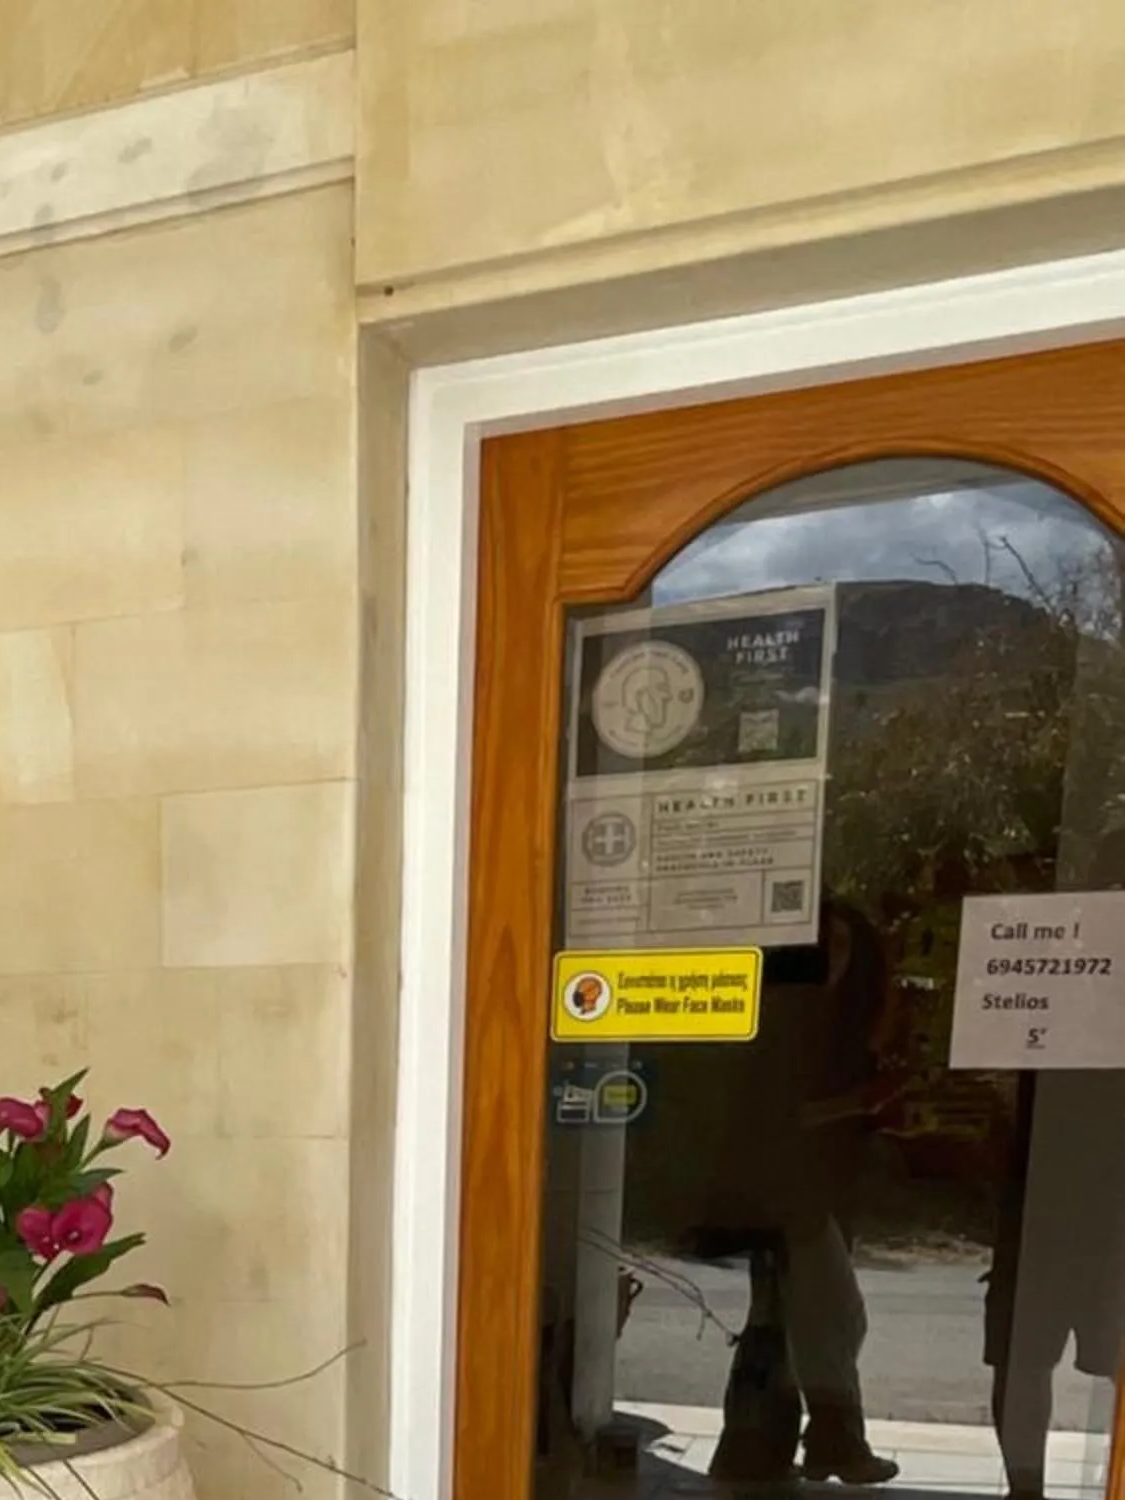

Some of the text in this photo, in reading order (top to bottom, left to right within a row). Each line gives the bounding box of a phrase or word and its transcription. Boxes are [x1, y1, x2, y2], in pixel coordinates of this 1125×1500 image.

[727, 631, 800, 652] HEALTH
[736, 646, 788, 664] FIRST
[746, 788, 808, 805] FIRST
[990, 921, 1080, 940] Call me !
[986, 957, 1112, 976] 6945721972
[617, 997, 651, 1015] Please
[682, 995, 708, 1014] Face
[981, 992, 1050, 1010] Stelios
